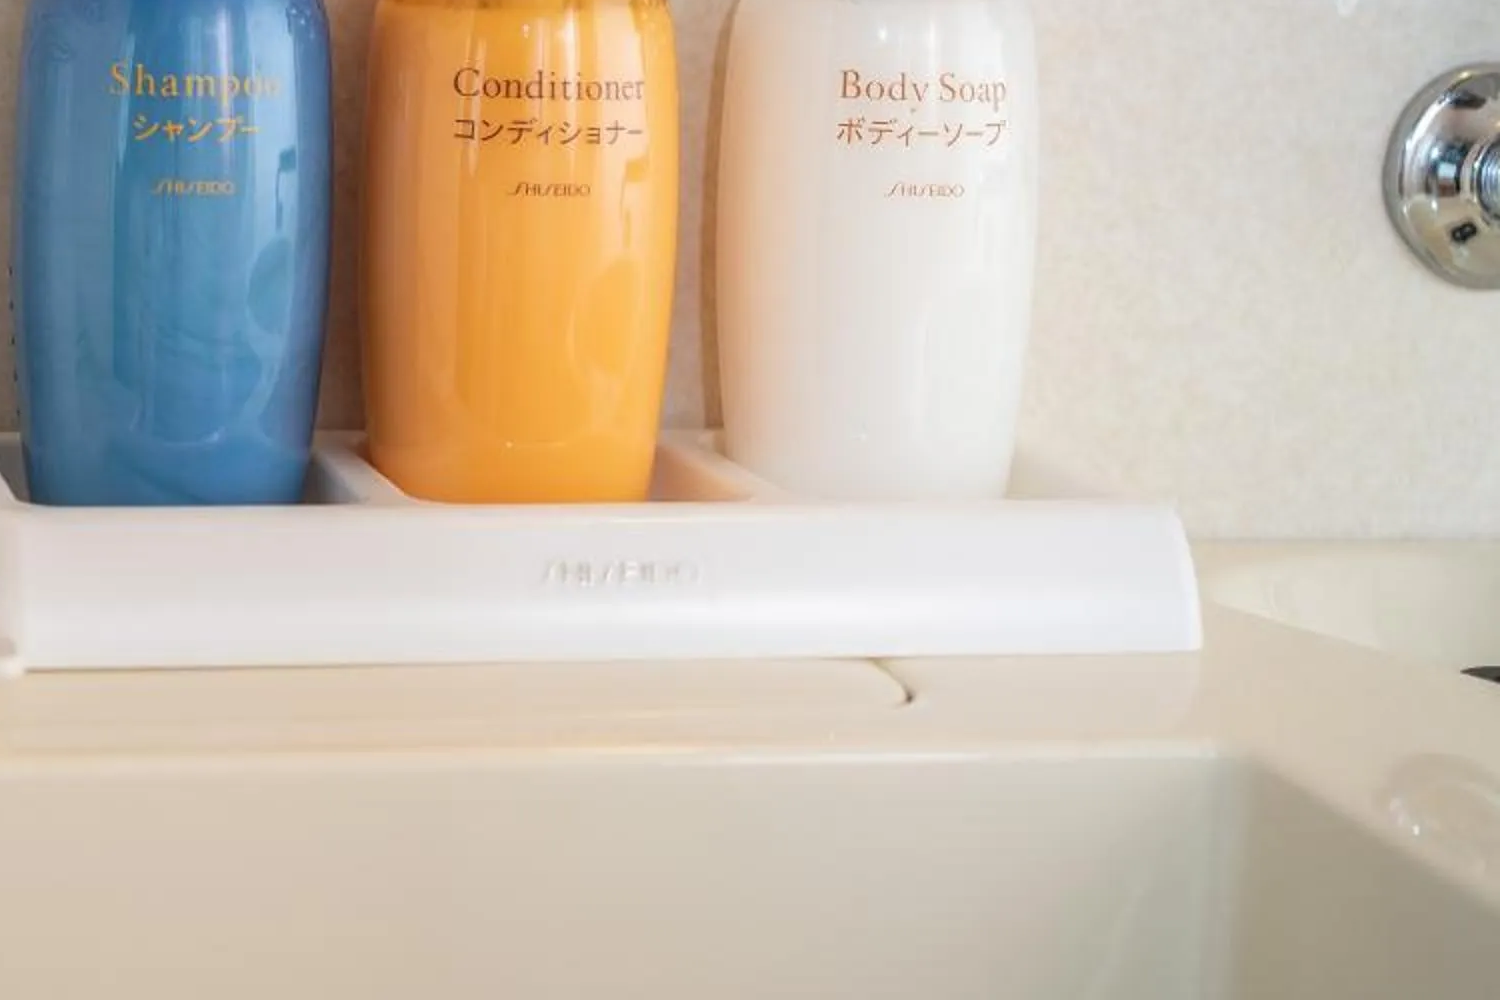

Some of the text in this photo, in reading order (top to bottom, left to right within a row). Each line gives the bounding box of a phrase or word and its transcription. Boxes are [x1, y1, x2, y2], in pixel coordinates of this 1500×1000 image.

[107, 61, 281, 110] Shampoo
[453, 68, 645, 101] Conditioner
[840, 69, 1008, 113] Body Soap
[132, 114, 261, 143] シャンプー
[453, 117, 644, 145] コンディショナー
[837, 116, 1008, 147] ボディーソープ
[507, 181, 592, 197] SHISEIDO
[885, 180, 966, 197] SHISEIDO
